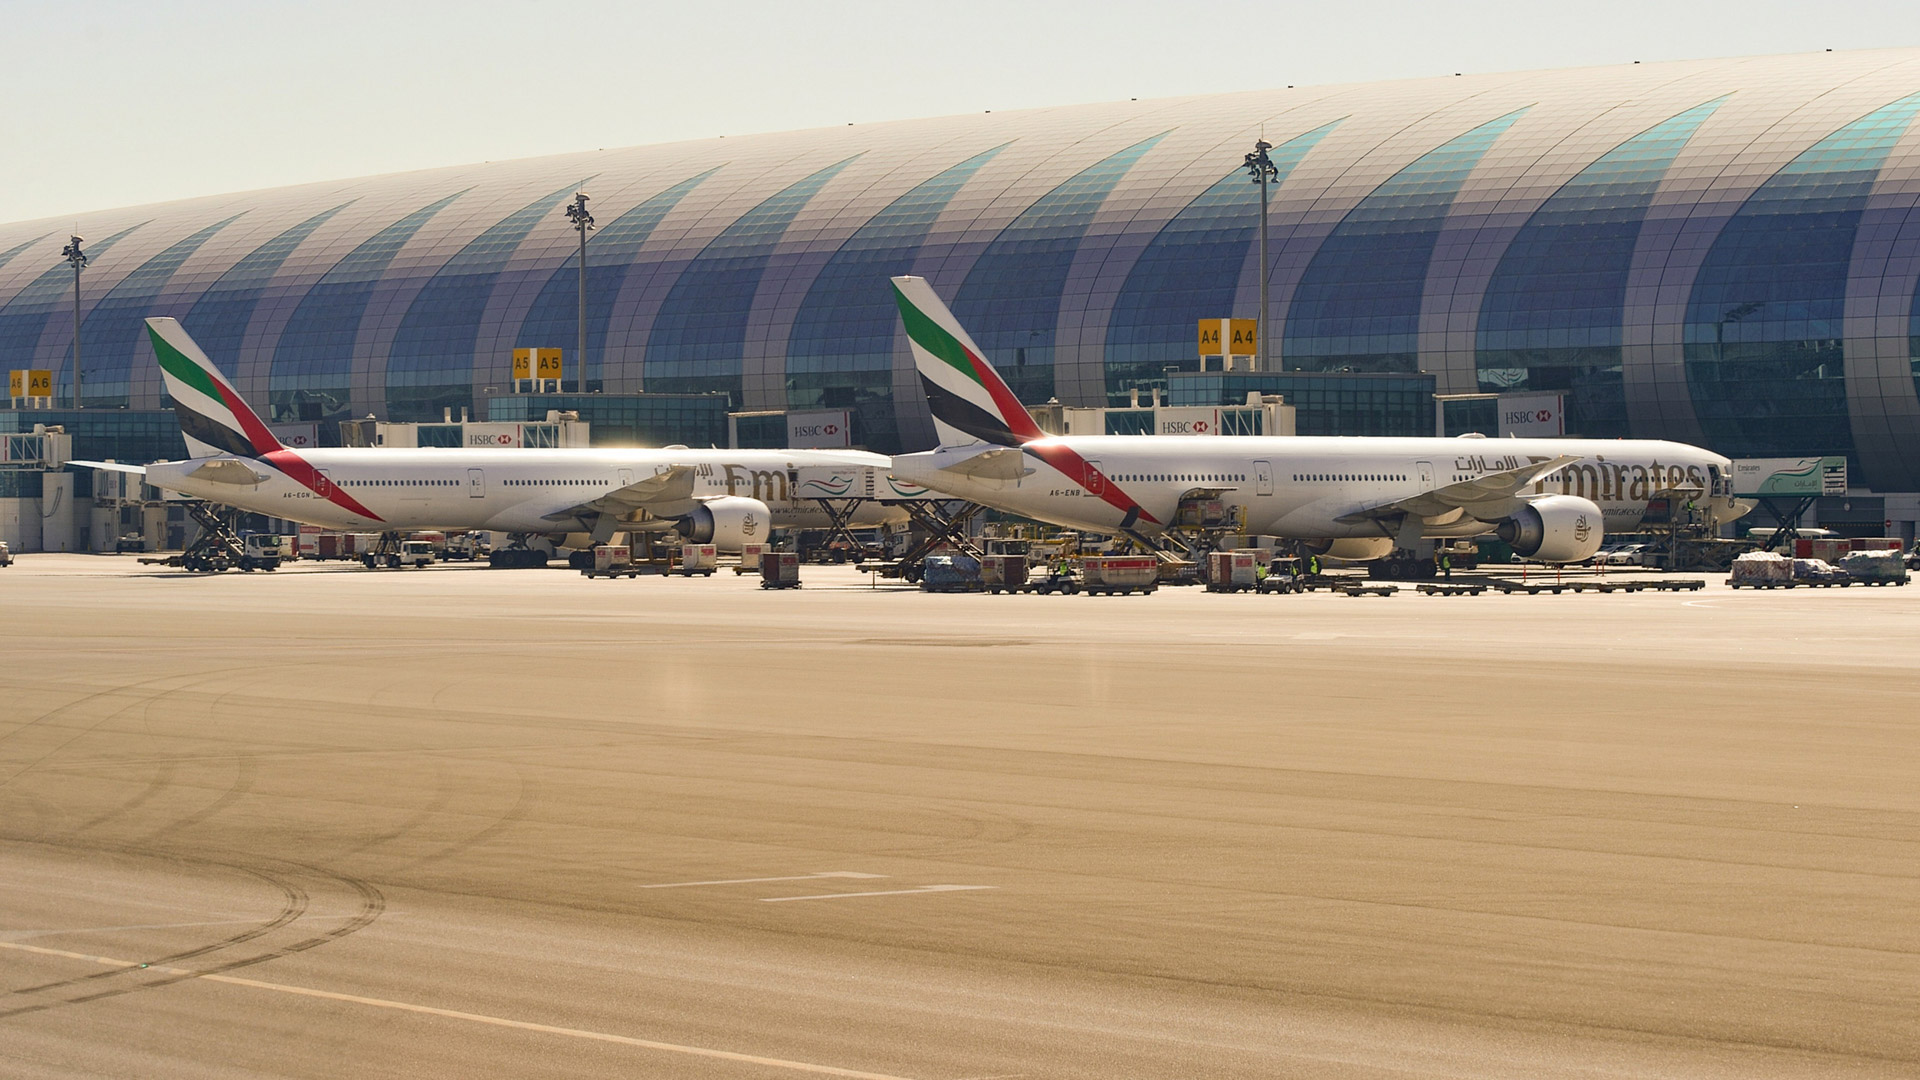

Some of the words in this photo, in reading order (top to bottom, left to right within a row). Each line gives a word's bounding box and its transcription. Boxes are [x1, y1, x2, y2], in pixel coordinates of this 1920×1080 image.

[1201, 330, 1219, 344] A4
[1233, 330, 1254, 344] A4
[515, 357, 529, 369] A5
[540, 357, 559, 369] A5
[31, 377, 49, 388] A6
[1505, 411, 1534, 424] HSBC
[794, 425, 822, 437] HSBC
[1162, 421, 1192, 433] HSBC
[470, 434, 496, 445] HSBC
